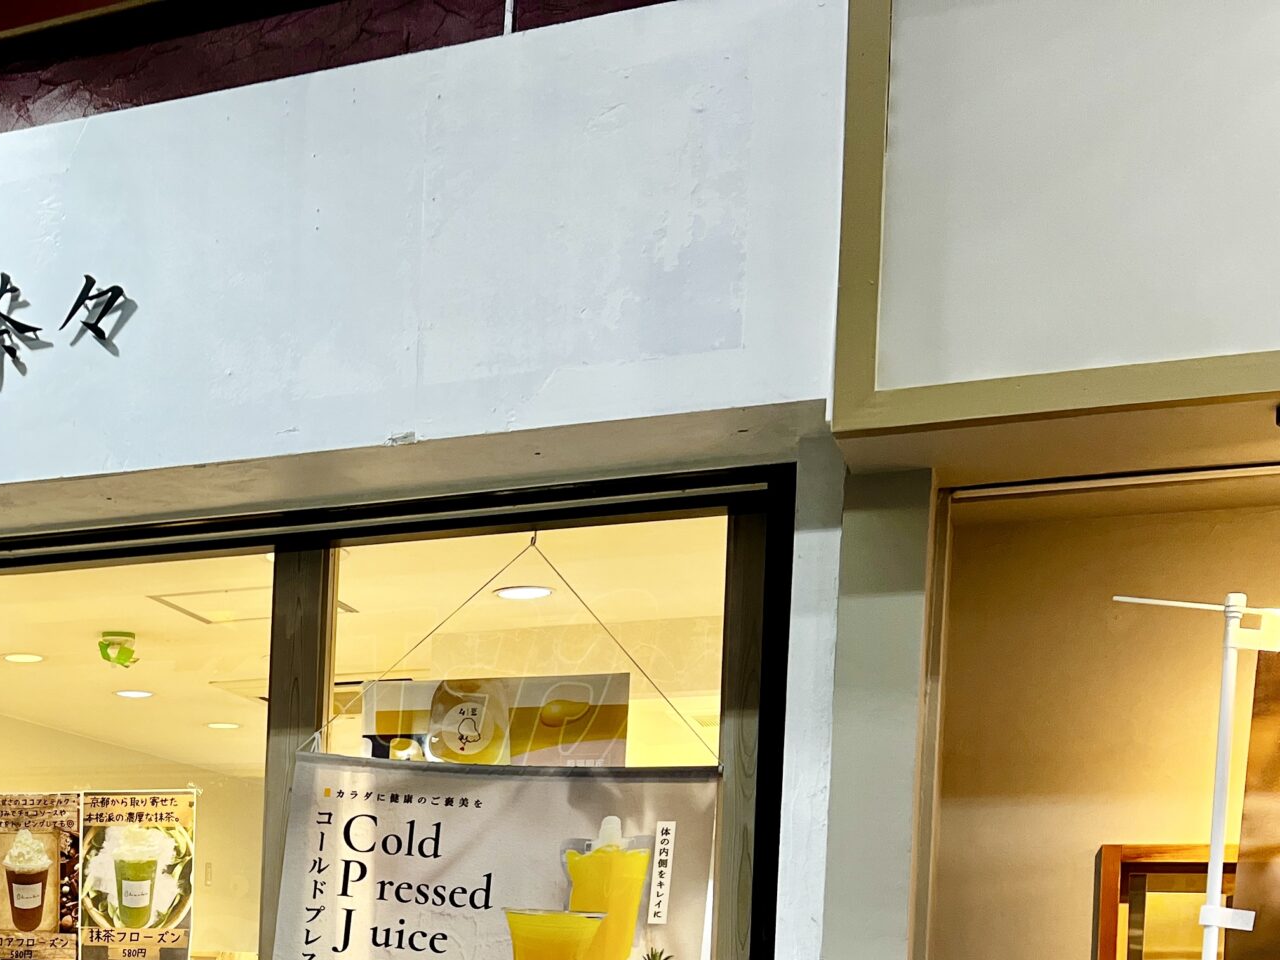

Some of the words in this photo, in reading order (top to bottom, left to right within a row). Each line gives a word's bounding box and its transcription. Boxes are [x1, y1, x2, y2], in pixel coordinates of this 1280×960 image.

[90, 797, 178, 808] 京都から取り寄せた
[336, 788, 483, 809] カラダに健康のご褒美を
[86, 812, 180, 823] 本格派の濃厚な抹茶。
[343, 814, 442, 858] Cold
[653, 827, 671, 918] 体の内側をキレイに
[337, 859, 493, 910] Pressed
[89, 929, 181, 943] 抹茶フローズン
[332, 908, 448, 954] Juice
[10, 950, 32, 959] 580円
[122, 948, 146, 958] 580円
